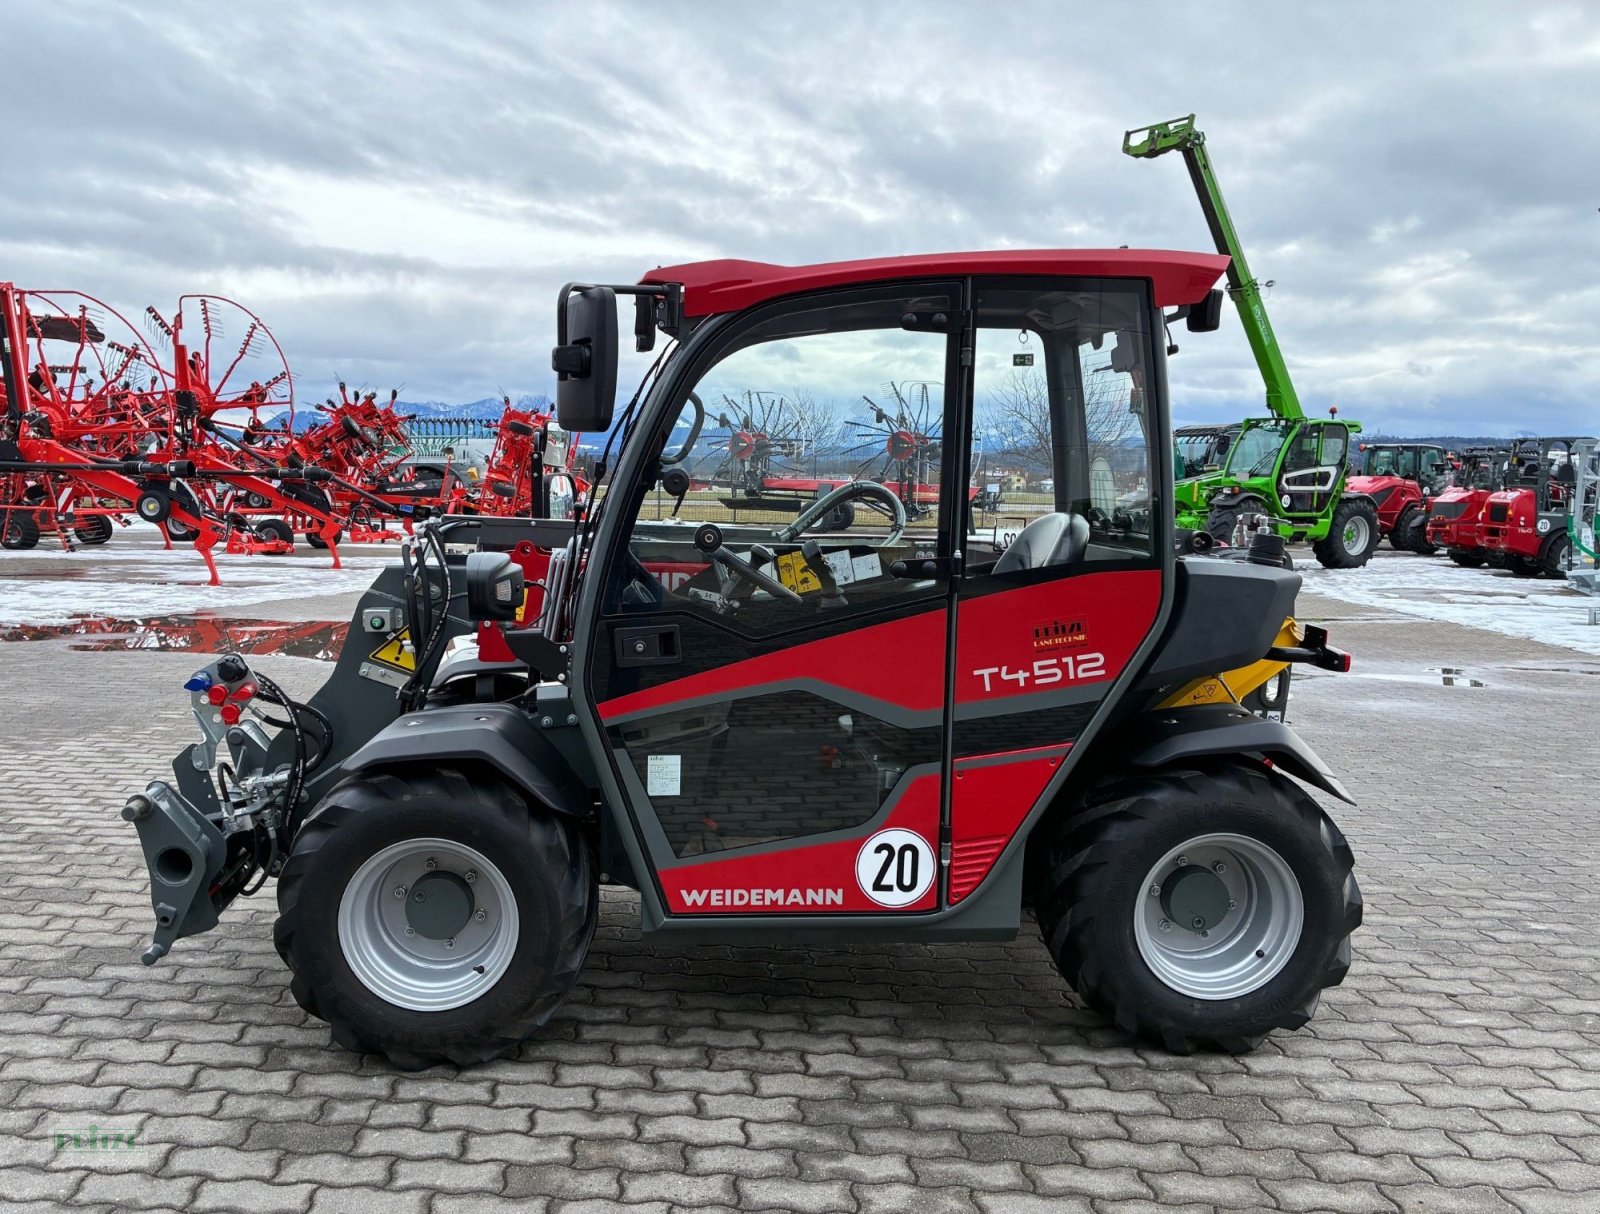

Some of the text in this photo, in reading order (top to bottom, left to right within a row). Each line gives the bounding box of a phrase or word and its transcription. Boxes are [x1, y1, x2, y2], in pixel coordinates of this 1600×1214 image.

[973, 652, 1106, 691] T4512
[872, 842, 919, 893] 20
[680, 888, 844, 907] WEIDEMANN
